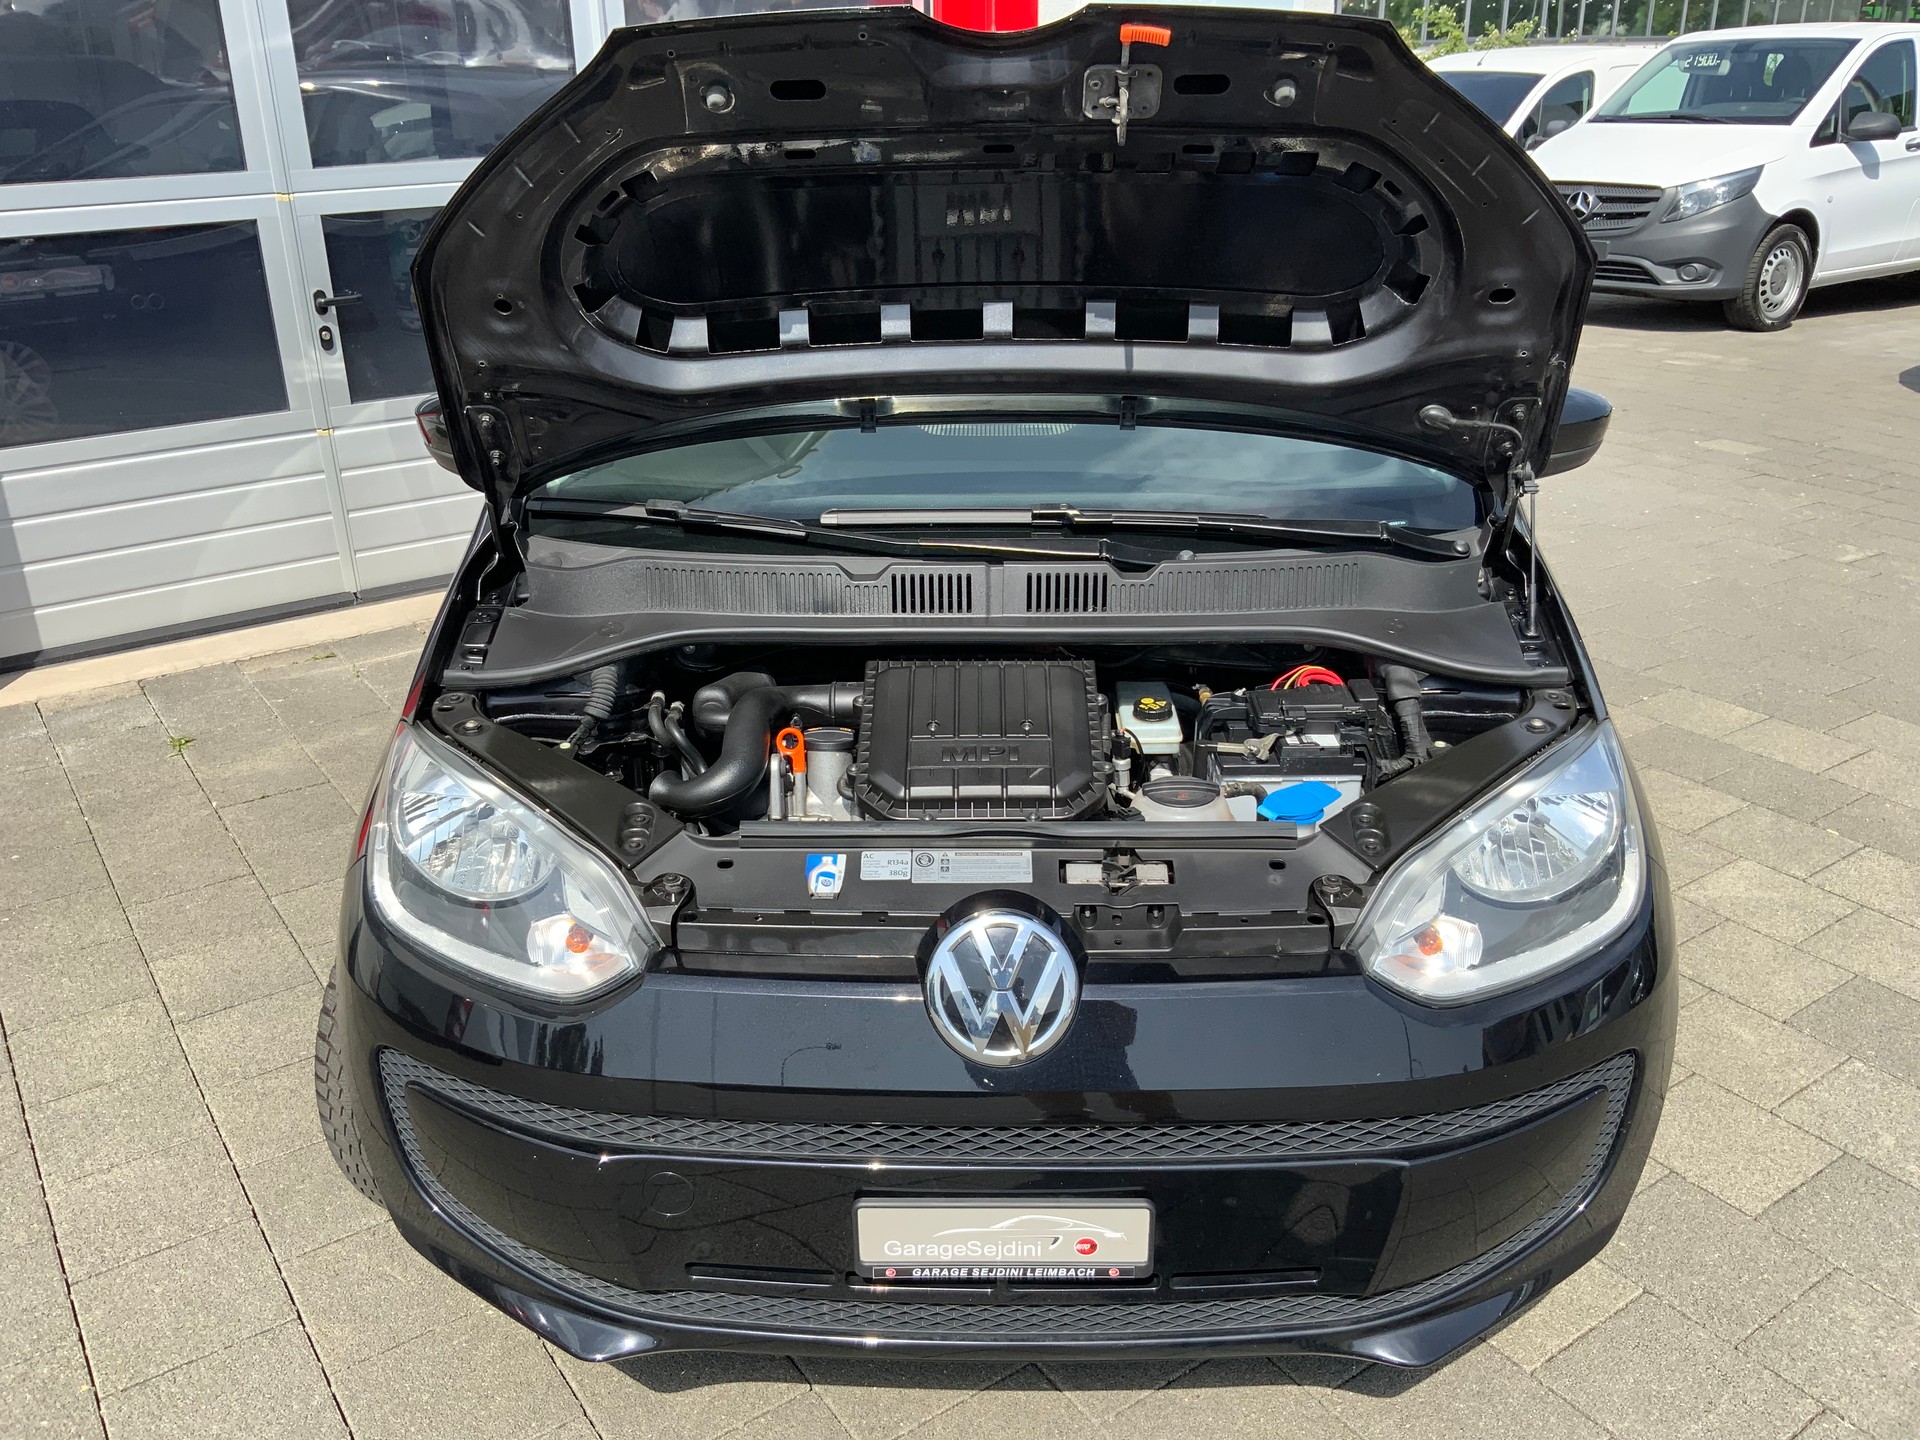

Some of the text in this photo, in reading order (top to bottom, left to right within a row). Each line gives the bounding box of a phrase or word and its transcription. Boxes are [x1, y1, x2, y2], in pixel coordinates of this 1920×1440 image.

[941, 744, 1019, 762] MPI
[889, 870, 908, 878] 380g
[926, 908, 1079, 1068] VW
[883, 1240, 1042, 1260] GarageSejdini
[912, 1267, 1096, 1277] GARAGE SEJDINI LEIMBACH
